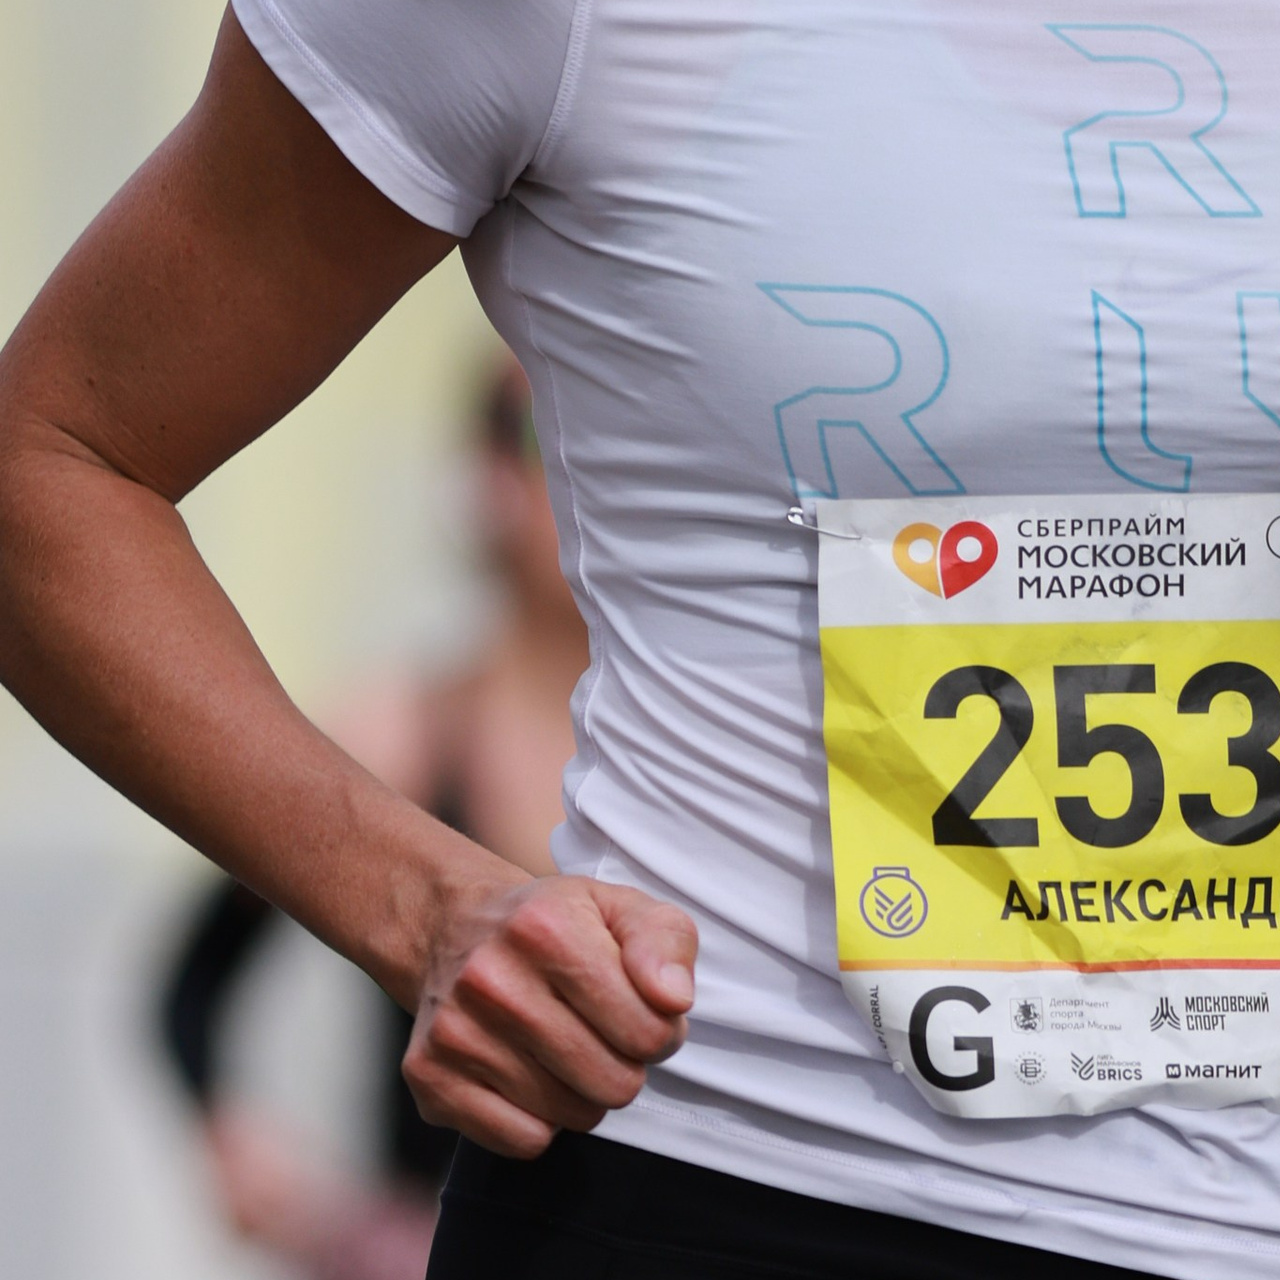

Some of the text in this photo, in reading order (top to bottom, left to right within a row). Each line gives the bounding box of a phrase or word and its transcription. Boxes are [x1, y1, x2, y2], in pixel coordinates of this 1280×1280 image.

[1044, 22, 1263, 219] R
[1017, 513, 1186, 538] СБЕРПРАЙМ
[1017, 538, 1247, 569] МОСКОВСКИЙ
[1017, 573, 1186, 600] МАРАФОН
[869, 984, 882, 1028] CORRAL
[1184, 992, 1270, 1013] МОСКОВСКИЙ
[1050, 1010, 1084, 1020] спорта
[1186, 1014, 1226, 1031] СПОРТ
[908, 985, 996, 1092] G
[1050, 1022, 1085, 1032] города
[1097, 1068, 1143, 1081] BRICS
[1184, 1063, 1262, 1079] магнит
